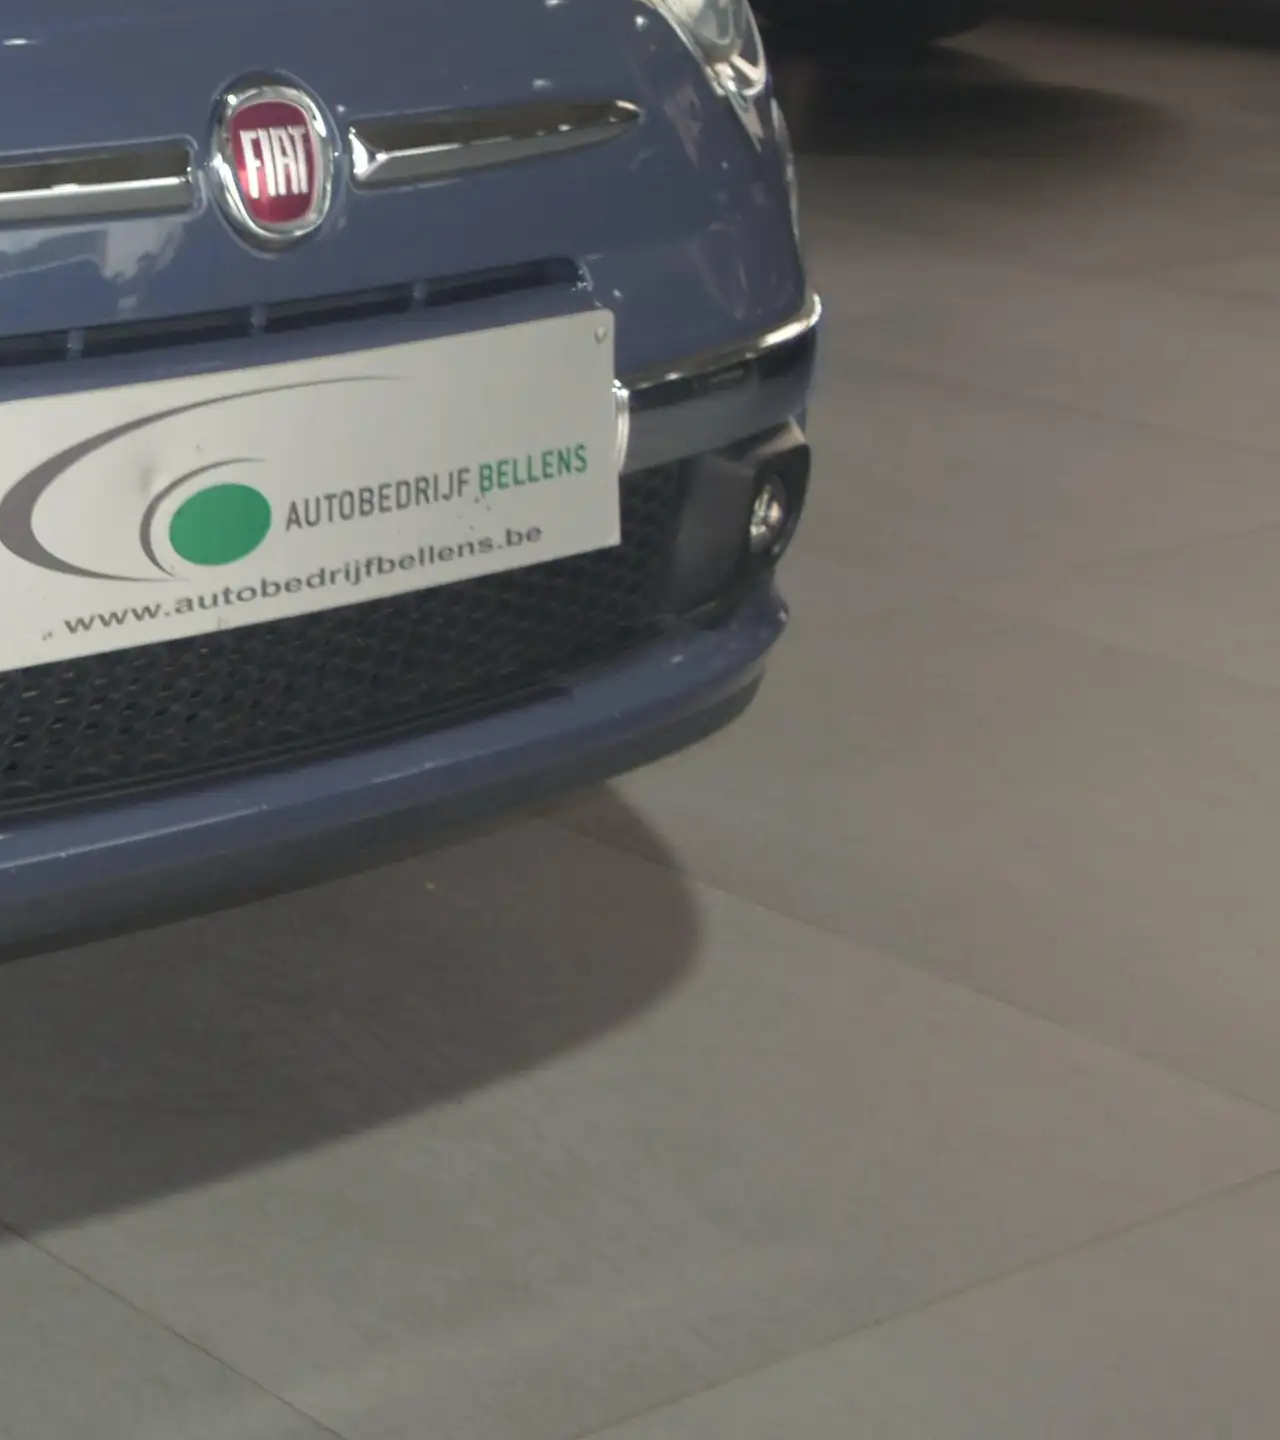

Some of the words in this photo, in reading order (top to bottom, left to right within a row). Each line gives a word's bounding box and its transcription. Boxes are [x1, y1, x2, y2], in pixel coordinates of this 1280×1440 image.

[239, 124, 309, 200] FIAT
[285, 467, 471, 533] AUTOBEDRIJF
[478, 443, 589, 494] BELLENS
[63, 524, 544, 636] www.autobedrijfbellens.be
